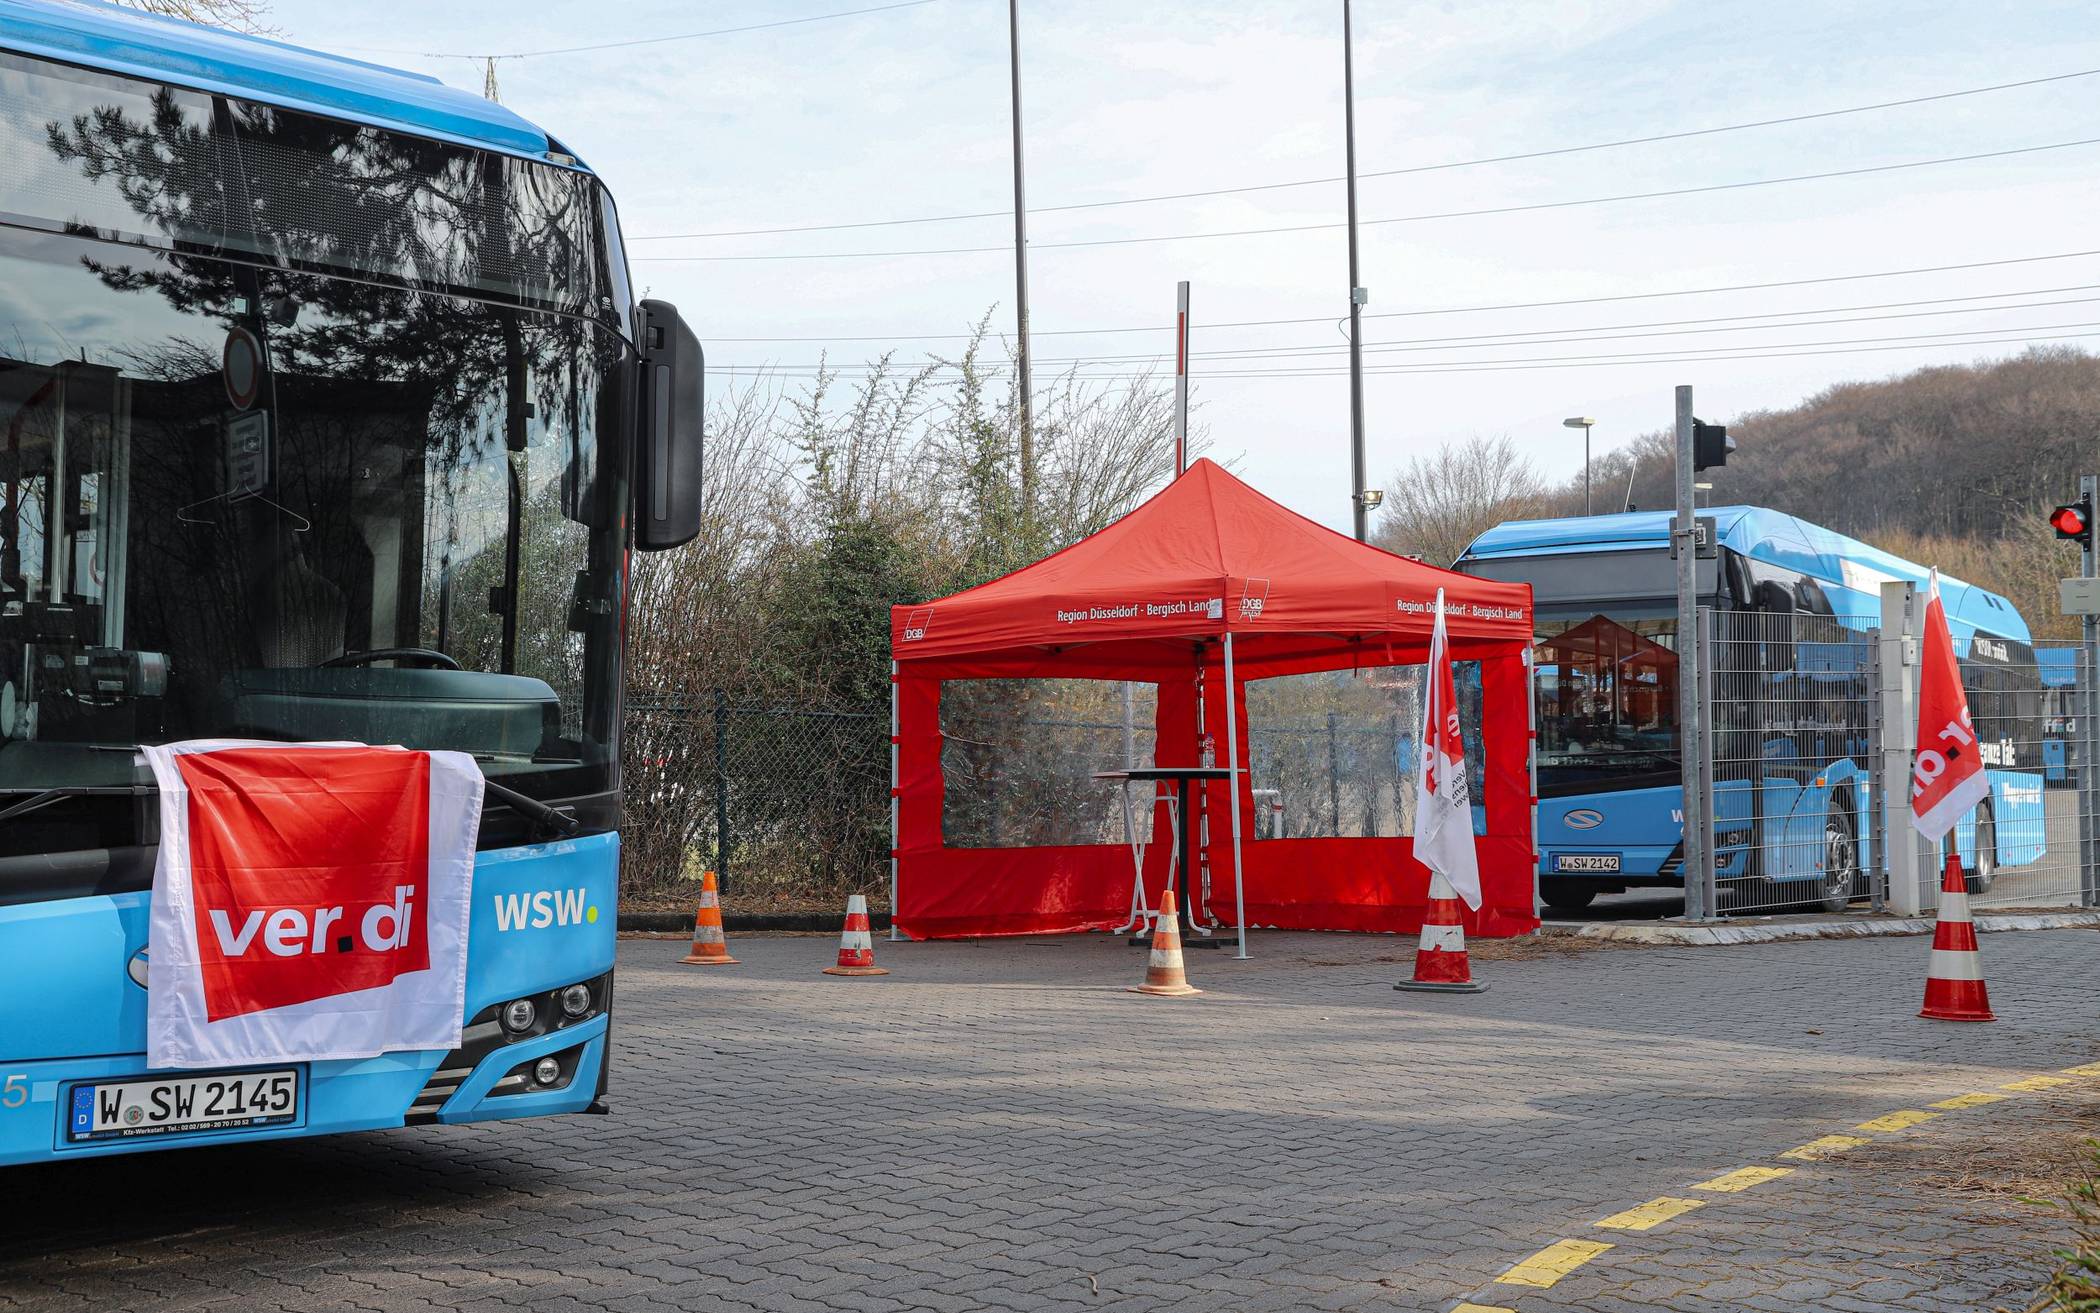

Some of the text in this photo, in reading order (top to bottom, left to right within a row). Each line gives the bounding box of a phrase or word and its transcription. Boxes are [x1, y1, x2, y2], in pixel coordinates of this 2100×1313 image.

[1057, 608, 1088, 624] Region
[1090, 605, 1138, 620] Düsseldorf
[1147, 601, 1186, 618] Bergisch
[1189, 598, 1213, 612] Land
[1243, 598, 1262, 609] DGB
[1397, 599, 1424, 614] Region
[1426, 601, 1466, 616] Düeldorf
[1472, 605, 1504, 620] Bergisch
[1505, 608, 1523, 619] Land
[906, 628, 923, 639] DGB
[1560, 857, 1617, 869] W SW 2142
[208, 884, 415, 957] ver.di
[3, 1074, 28, 1108] 5
[100, 1077, 292, 1125] W SW 2145
[78, 1114, 87, 1125] D
[123, 1127, 165, 1136] Kfz-Werkstatt
